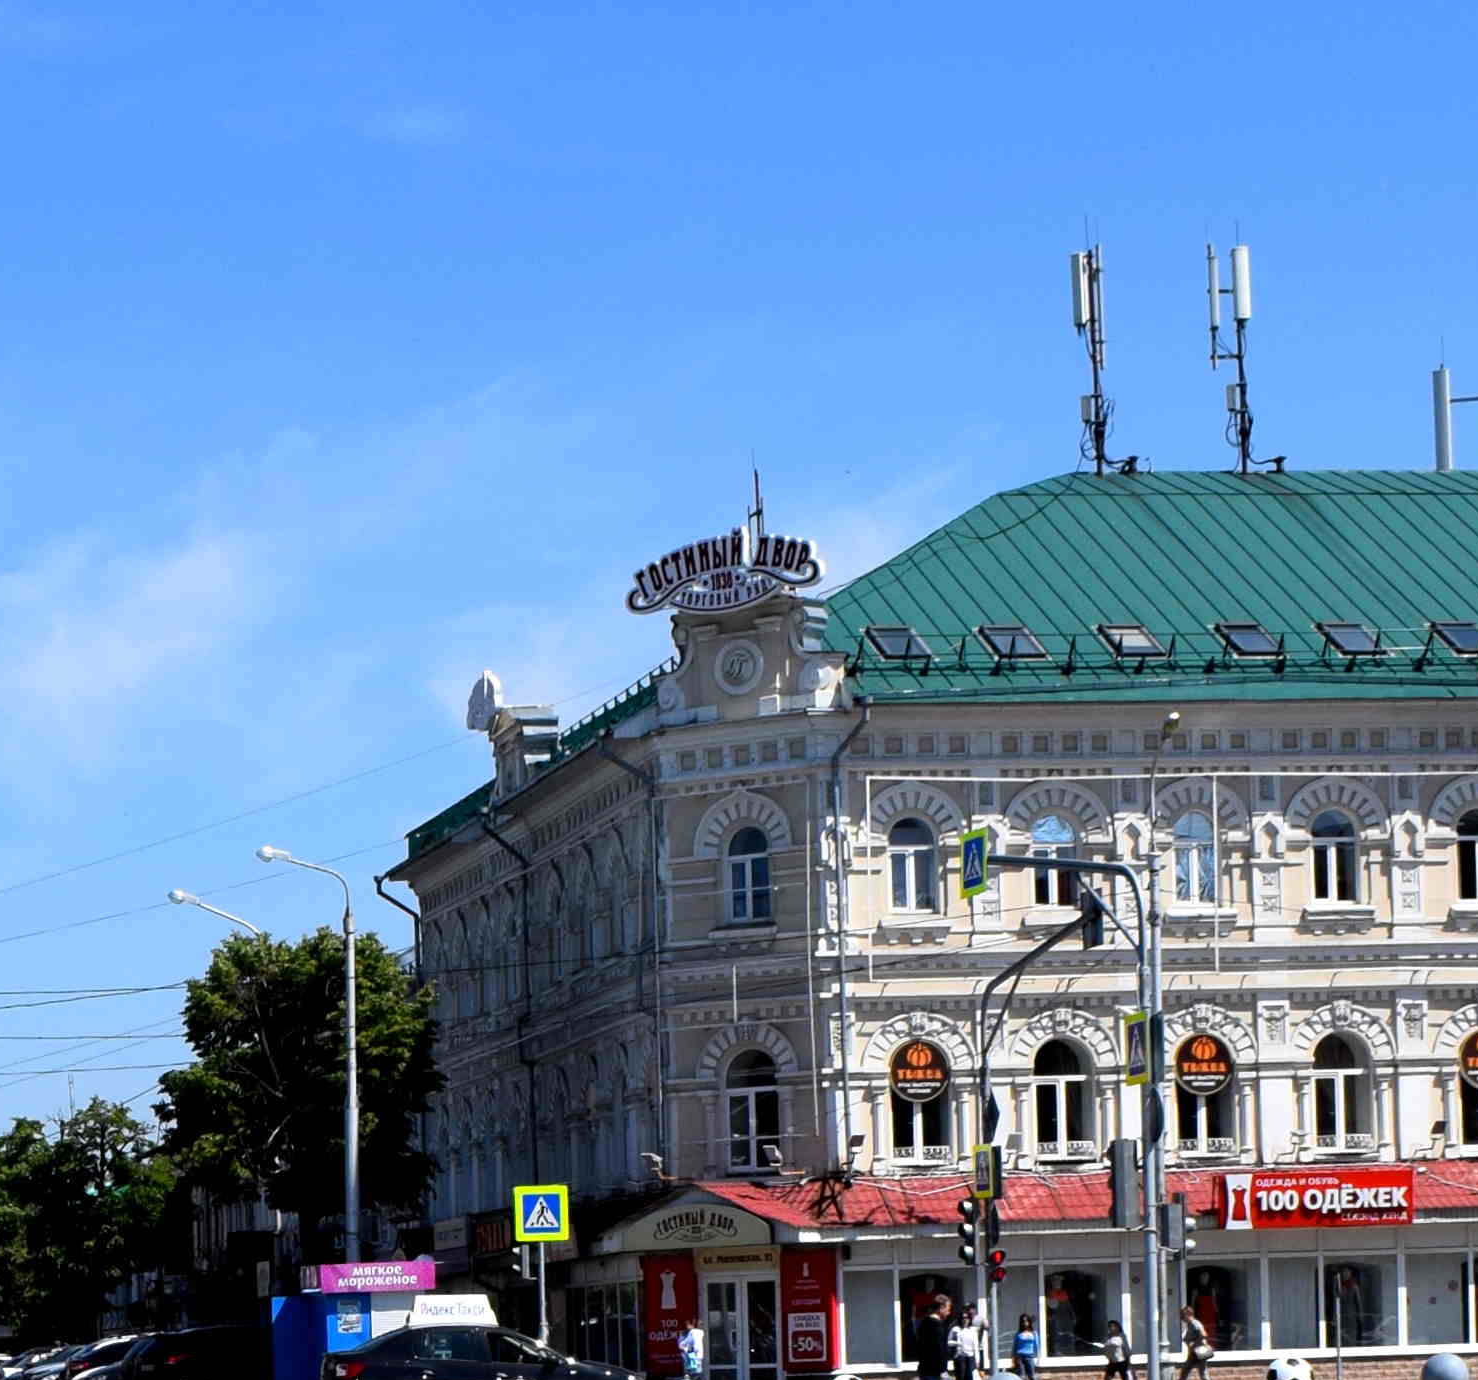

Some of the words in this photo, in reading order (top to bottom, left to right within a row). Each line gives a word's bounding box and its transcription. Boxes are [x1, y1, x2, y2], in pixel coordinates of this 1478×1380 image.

[634, 527, 744, 599] ГОСТИНЫЙ
[753, 536, 811, 573] ДВОР
[1255, 1178, 1297, 1187] ОДЕЖДА
[1299, 1178, 1306, 1186] И
[1307, 1176, 1340, 1186] ОБУВЬ
[1255, 1189, 1300, 1212] 100
[1302, 1184, 1409, 1214] ОДЁЖЕК
[352, 1265, 404, 1277] мягкое
[337, 1274, 418, 1290] мороженое
